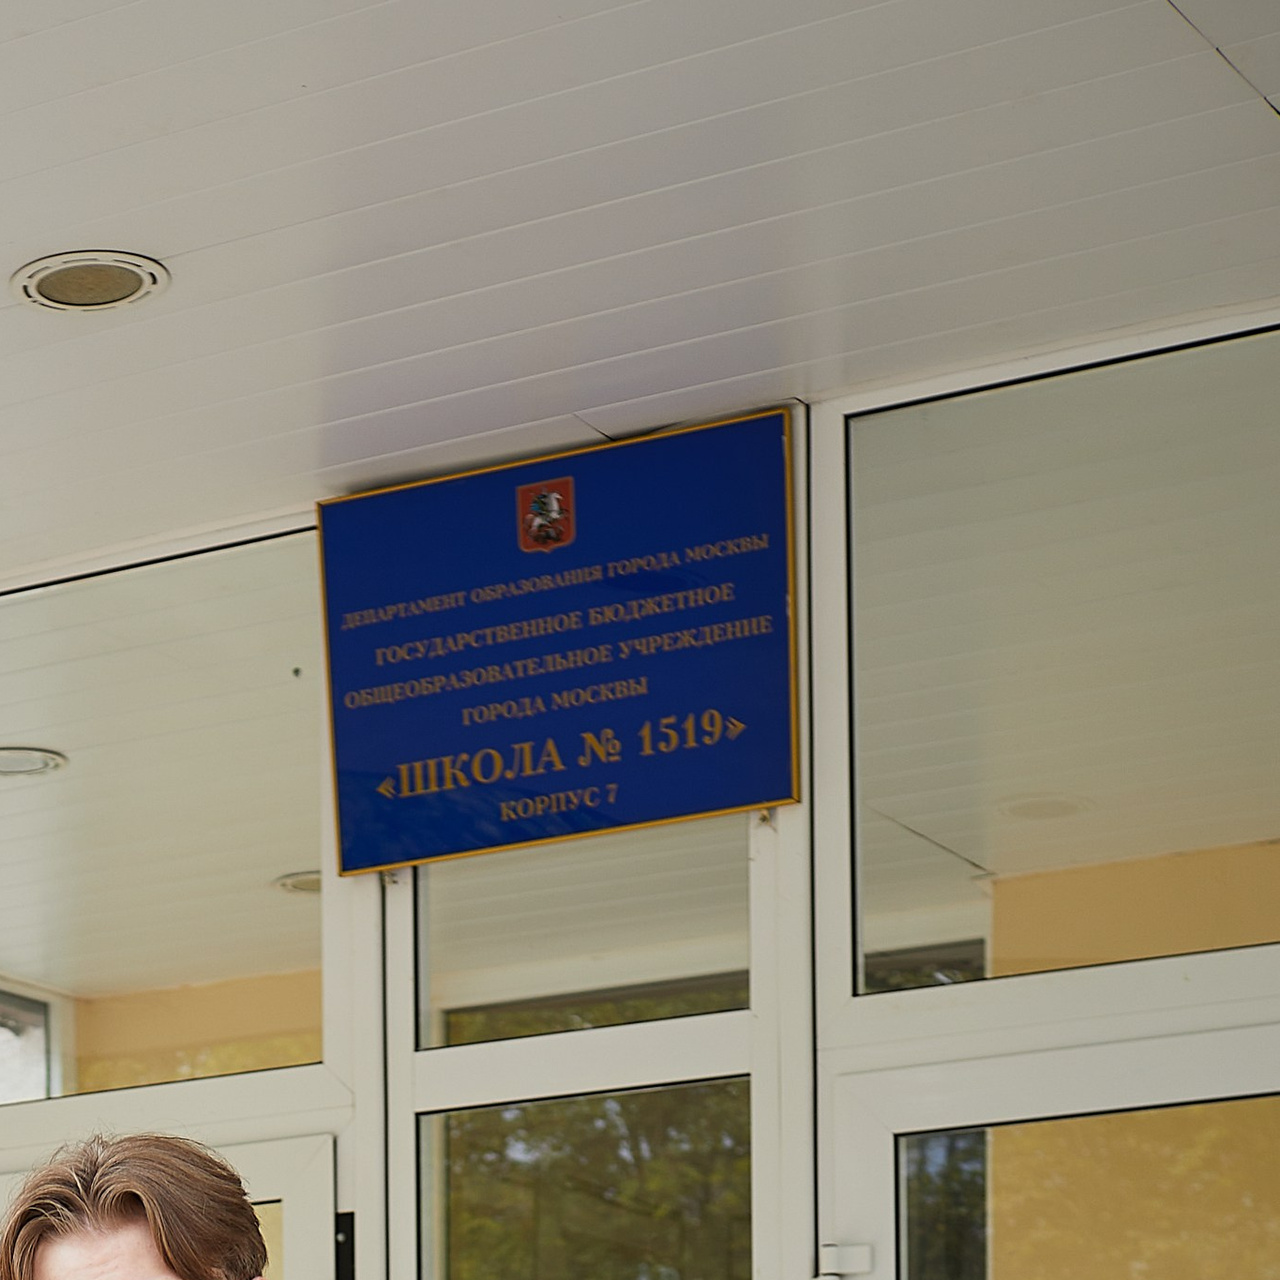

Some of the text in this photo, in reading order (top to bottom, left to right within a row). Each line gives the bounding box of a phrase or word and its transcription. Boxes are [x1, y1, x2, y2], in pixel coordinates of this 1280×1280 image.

[341, 533, 769, 631] ДЕПАРТАМЕНТ ОБРАЗОВАНИЯ ГОРОДА МОСКВЫ
[375, 582, 736, 667] ГОСУДАРСТВЕННОЕ БЮДЖЕТНОЕ
[344, 614, 773, 709] ОБЩЕОБРАЗОВАТЕЛЬНОЕ УЧРЕЖДЕНИЕ
[462, 676, 648, 726] ГОРОДА МОСКВЫ
[376, 708, 748, 798] «ШКОЛА № 1519»
[500, 783, 619, 822] КОРПУС 7
